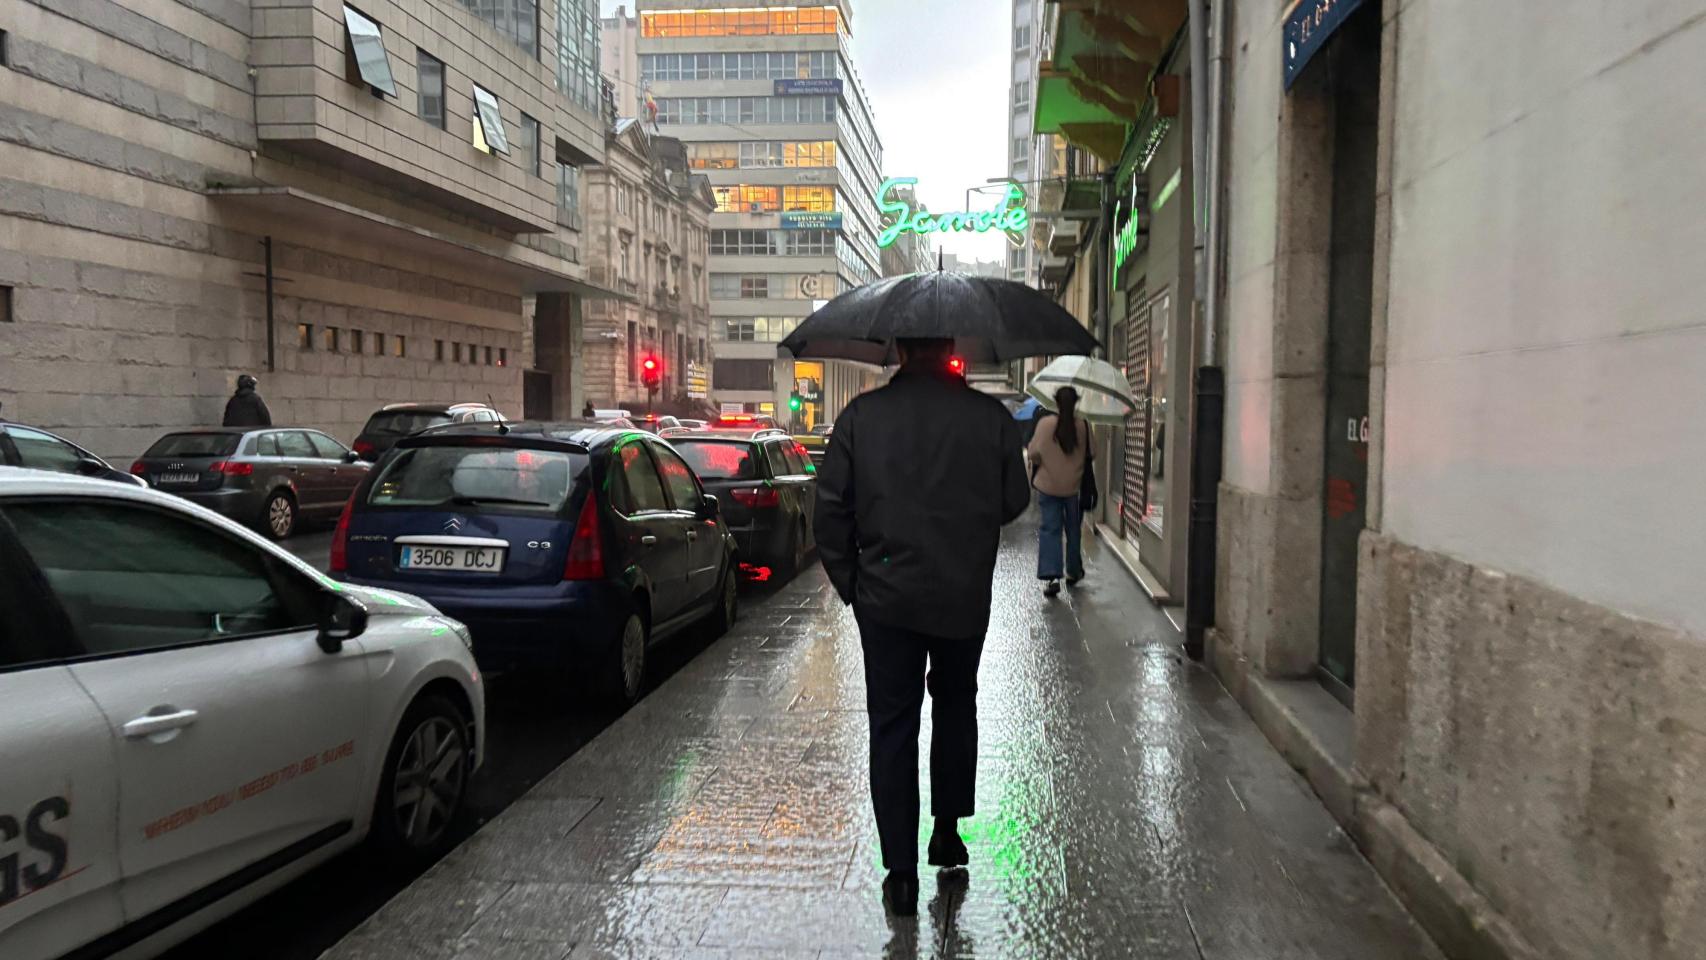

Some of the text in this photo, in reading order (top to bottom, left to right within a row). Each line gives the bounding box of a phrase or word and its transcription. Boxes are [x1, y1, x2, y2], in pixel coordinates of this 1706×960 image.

[1347, 417, 1370, 442] EL G
[527, 540, 552, 550] C3
[413, 548, 496, 569] 3506 DCJ
[144, 804, 200, 839] WHEN
[201, 791, 234, 816] YOU
[239, 771, 279, 800] NEED
[301, 754, 318, 773] BE
[322, 739, 354, 765] SURE
